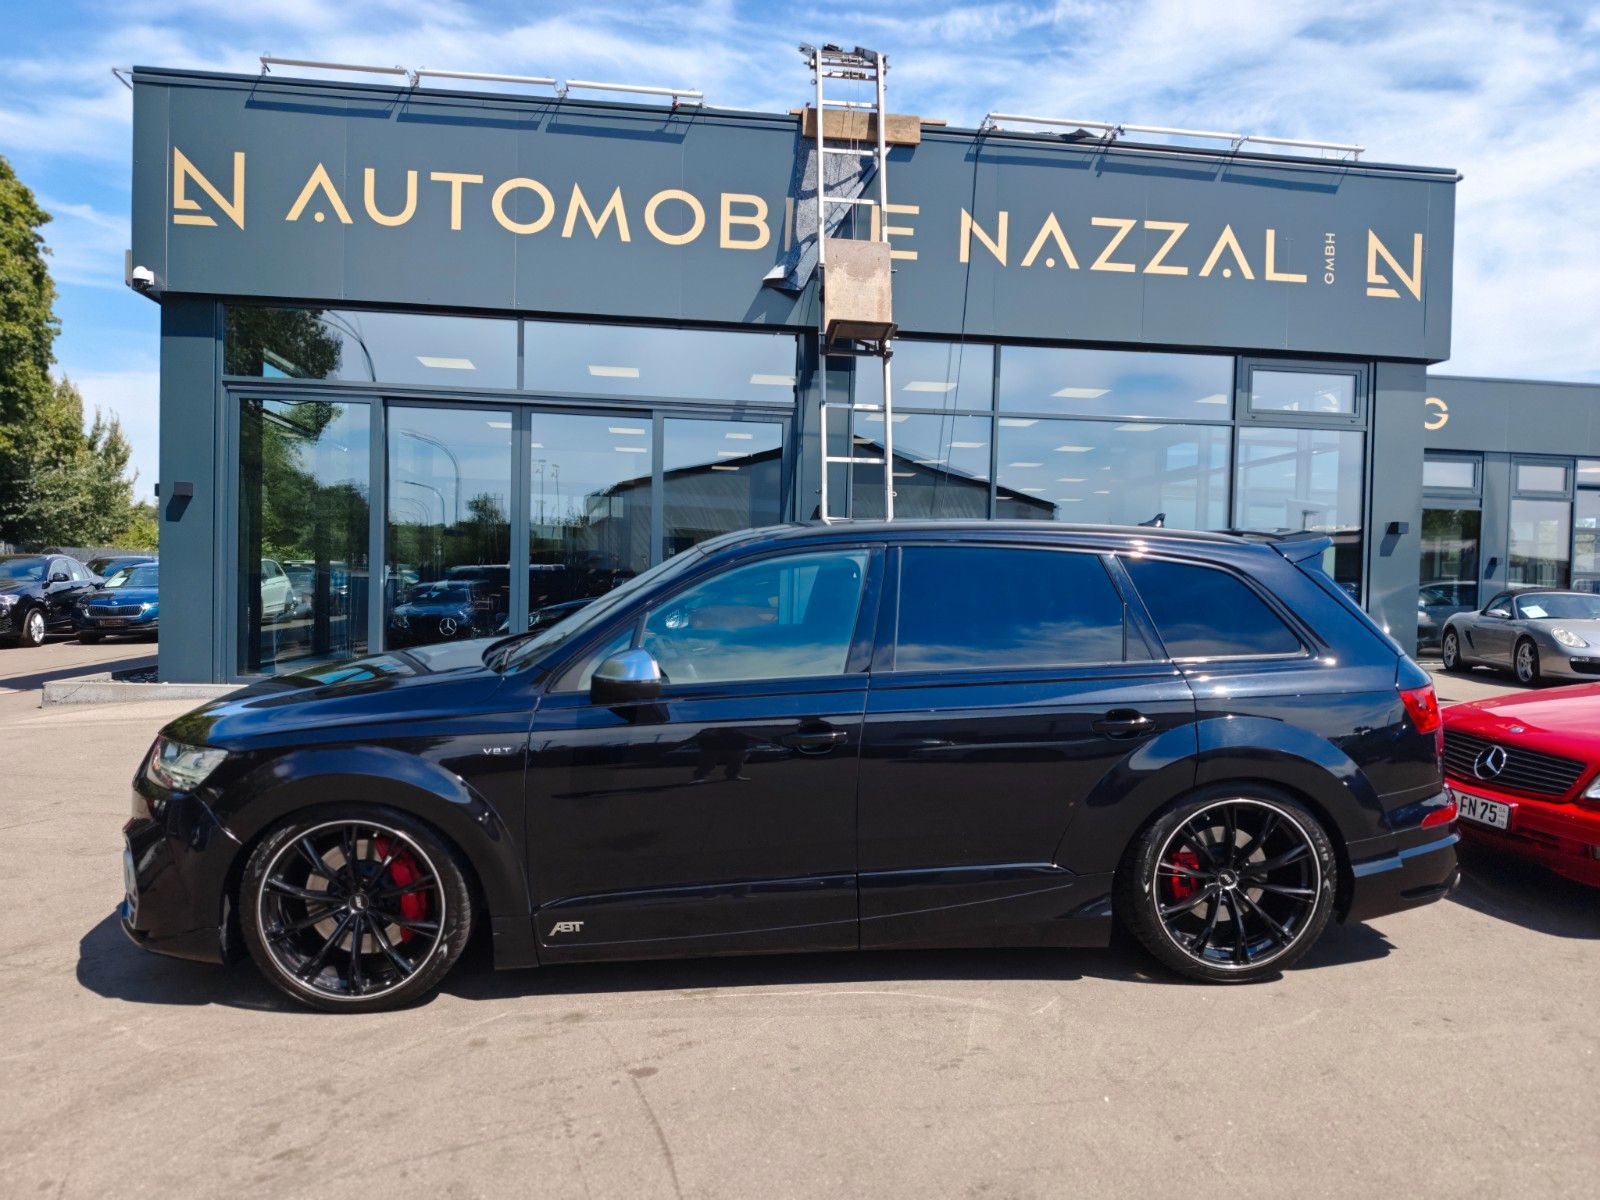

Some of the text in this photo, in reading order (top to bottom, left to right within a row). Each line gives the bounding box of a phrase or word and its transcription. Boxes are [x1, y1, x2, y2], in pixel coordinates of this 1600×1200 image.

[285, 162, 1308, 284] AUTOMOBIE NAZZAL
[1324, 232, 1336, 285] GMBH
[482, 746, 512, 755] V8T
[1460, 795, 1497, 823] FN 75
[548, 921, 585, 937] ABT
